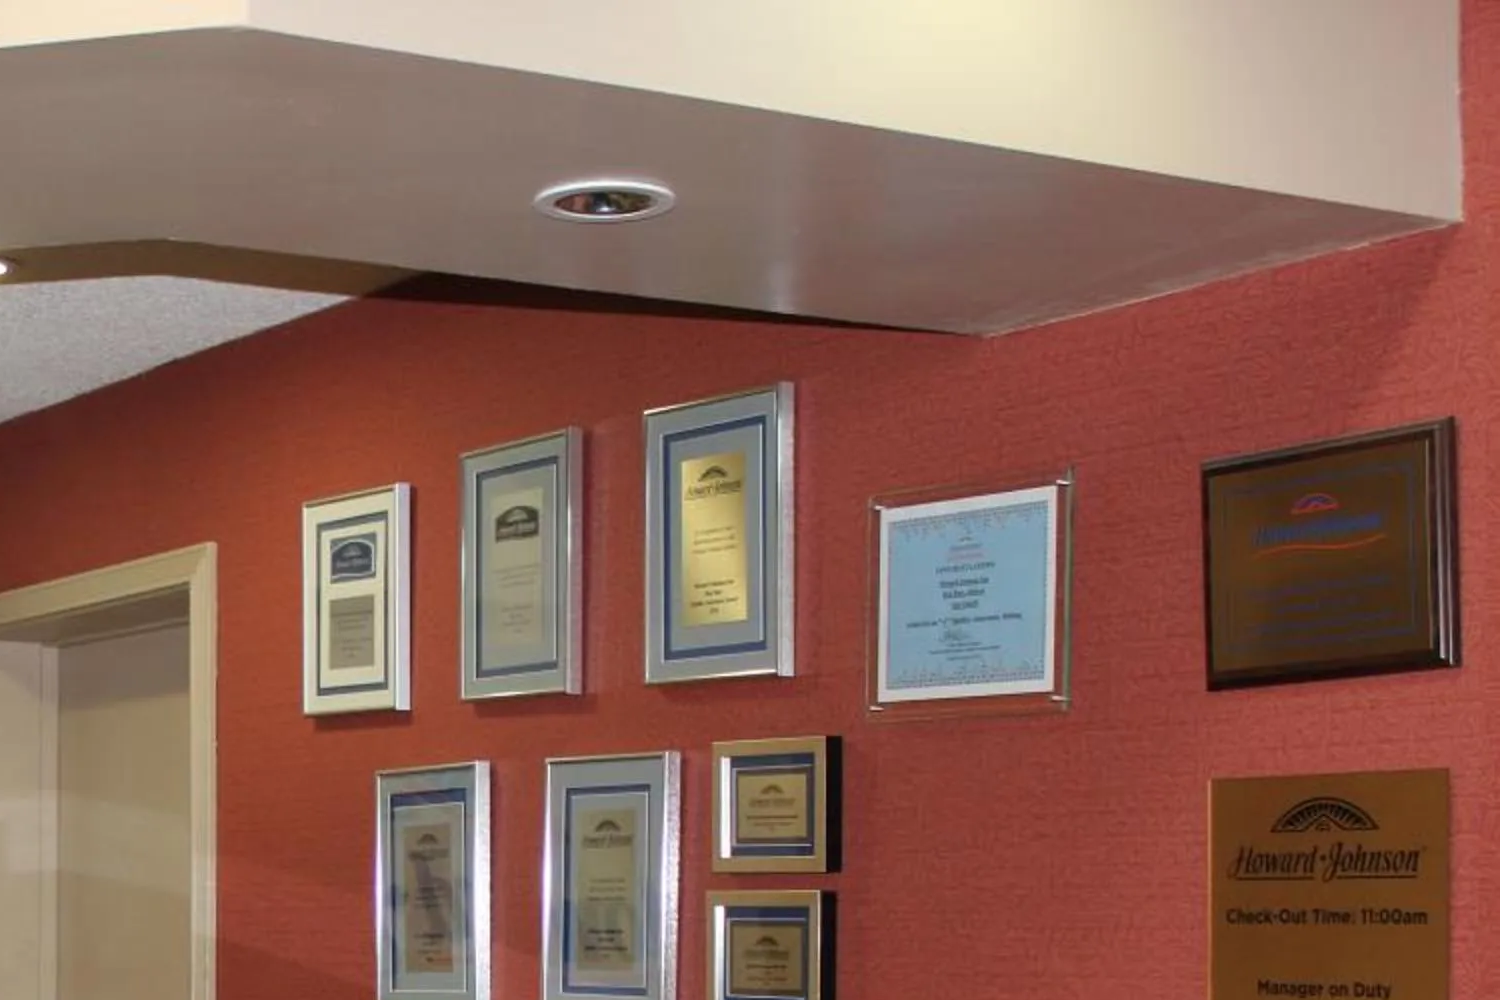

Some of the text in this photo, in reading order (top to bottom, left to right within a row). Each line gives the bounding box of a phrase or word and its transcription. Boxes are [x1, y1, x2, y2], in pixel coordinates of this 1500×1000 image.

[1227, 842, 1421, 883] Howard Johnson
[1226, 907, 1428, 926] Check-Out Time: 11:00am
[1257, 979, 1324, 999] Manager
[1329, 984, 1350, 998] on
